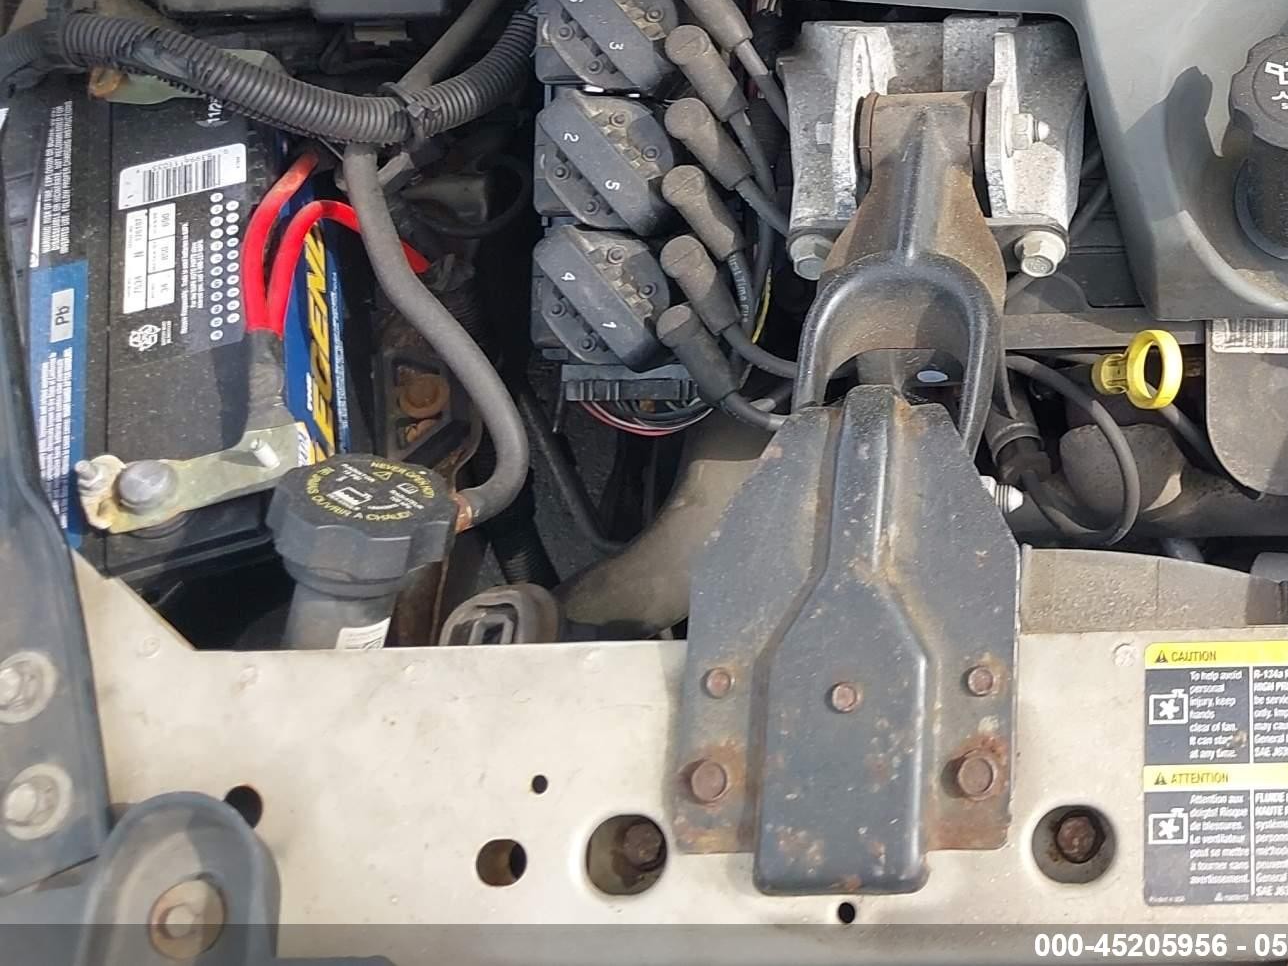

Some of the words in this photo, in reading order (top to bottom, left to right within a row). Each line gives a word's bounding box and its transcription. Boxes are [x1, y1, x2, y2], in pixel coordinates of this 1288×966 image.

[608, 40, 625, 52] 3
[563, 131, 580, 144] 2
[604, 179, 621, 192] 5
[560, 271, 576, 283] 4
[55, 305, 70, 326] Pb
[602, 320, 618, 331] 1
[370, 461, 407, 475] NEVER
[1171, 650, 1217, 663] CAUTION
[1190, 671, 1200, 681] To
[1201, 670, 1219, 683] help
[1220, 670, 1243, 681] avoid
[1189, 722, 1210, 732] clear
[1211, 722, 1221, 732] of
[1253, 733, 1285, 744] General
[1171, 772, 1229, 784] ATTENTION
[1189, 794, 1228, 804] Attention
[1255, 872, 1288, 883] General
[1255, 885, 1274, 896] SAE
